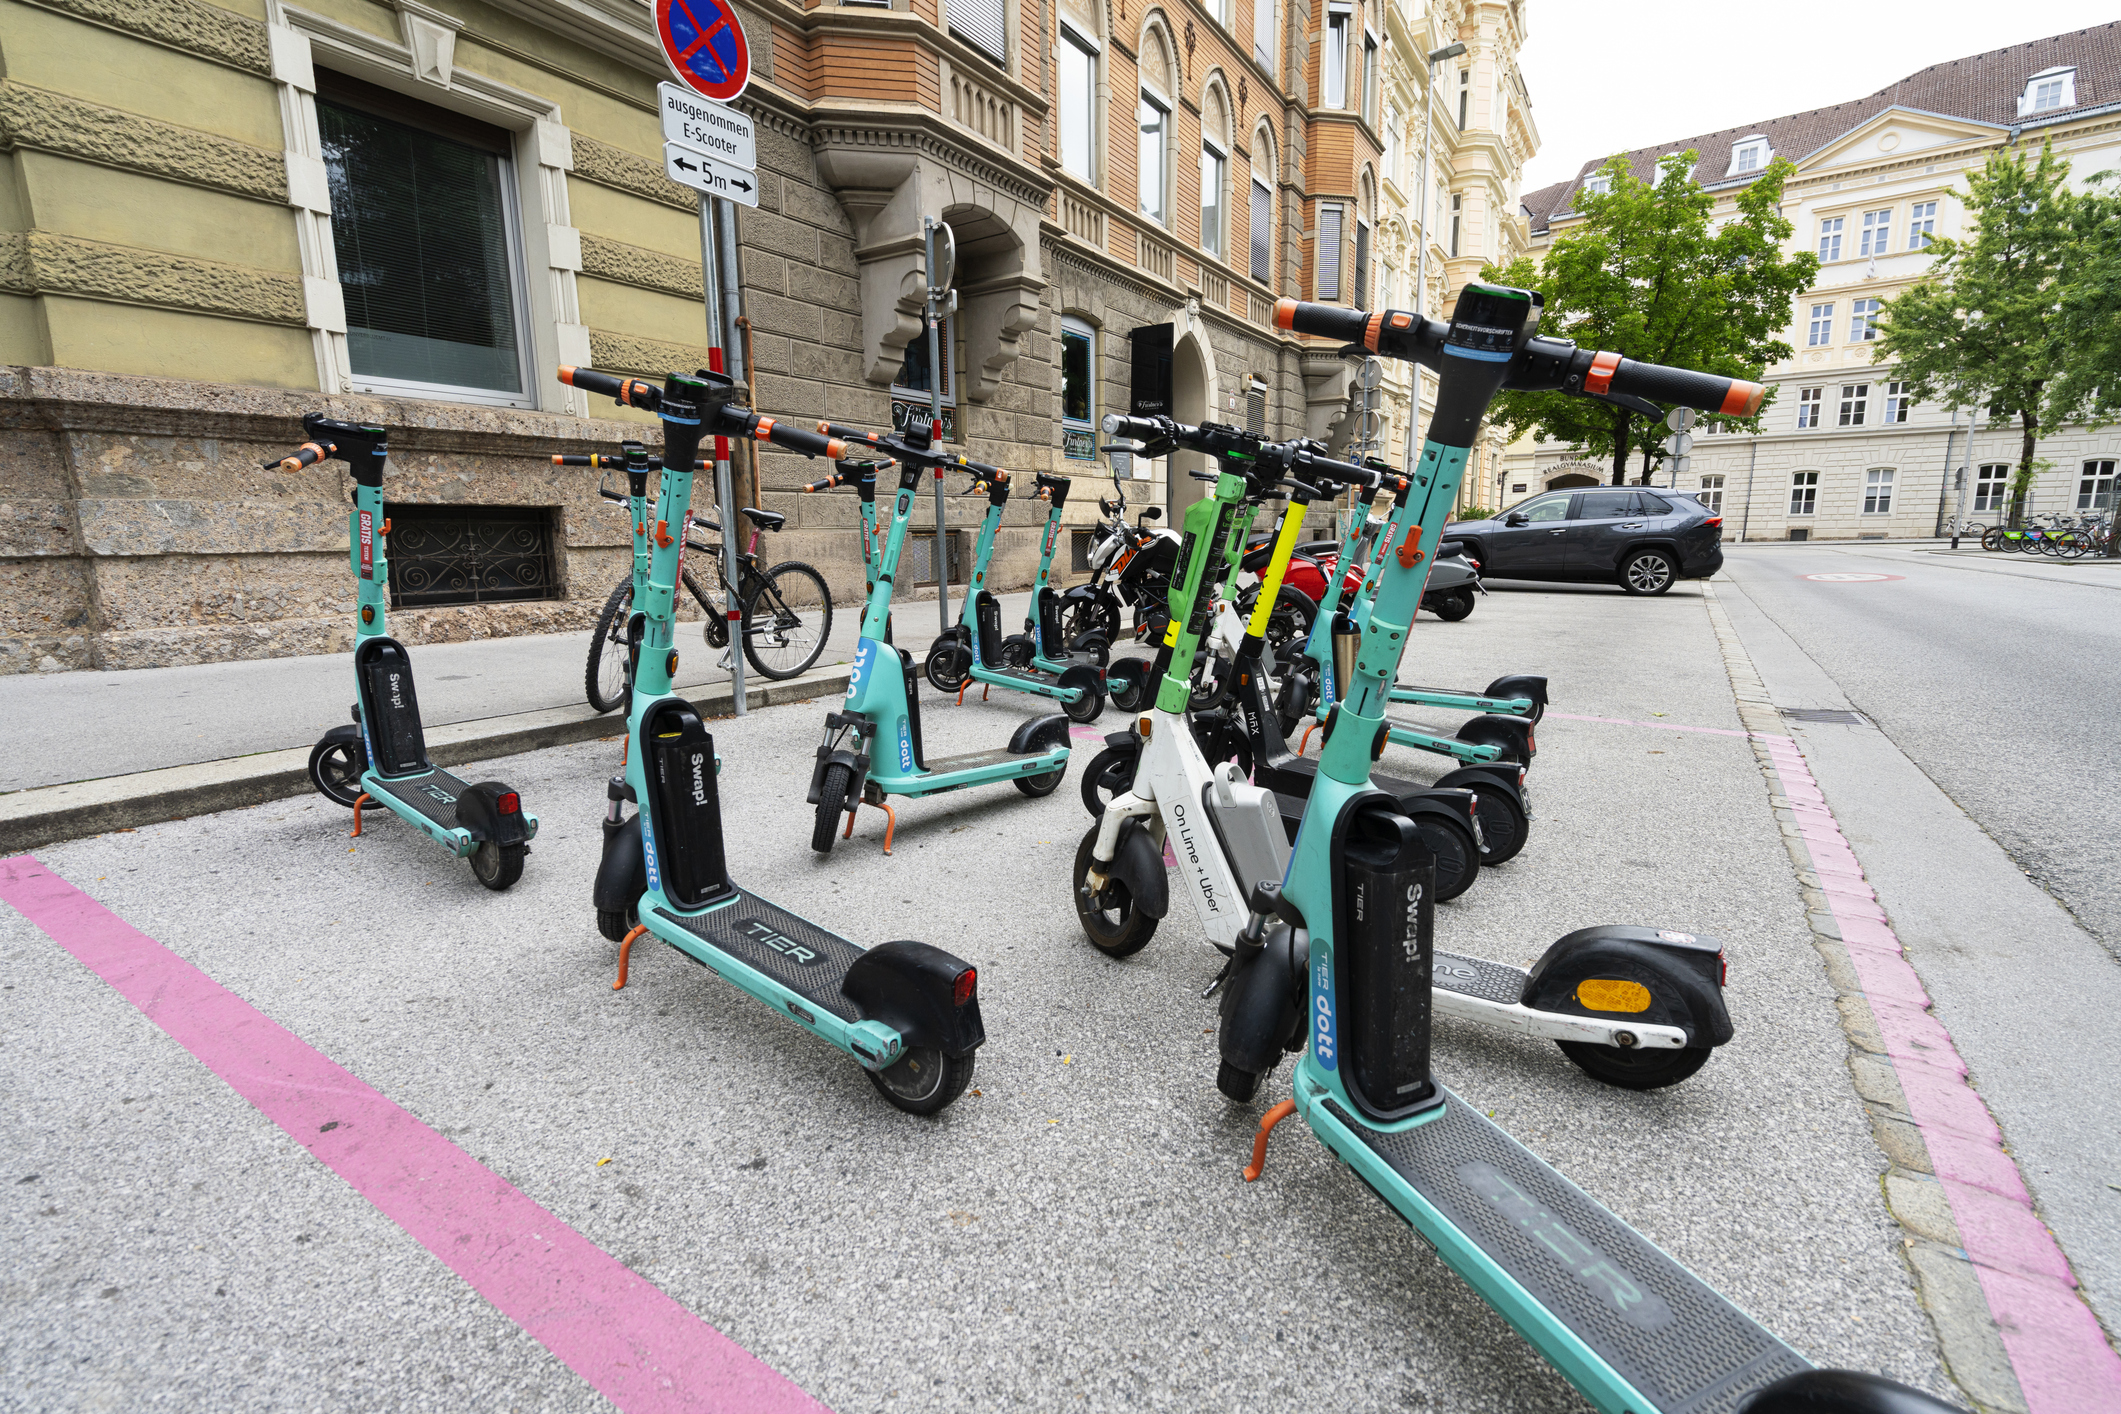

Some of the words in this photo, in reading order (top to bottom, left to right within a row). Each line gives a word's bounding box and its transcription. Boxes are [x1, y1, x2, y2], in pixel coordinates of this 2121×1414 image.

[668, 96, 749, 138] ausgenommen
[683, 122, 737, 155] E-Scooter
[702, 161, 727, 190] 5m
[1455, 322, 1514, 336] SICHERHEITSVORSCHRIFTEN
[901, 404, 952, 430] Furtnr's
[1543, 461, 1605, 475] REALGYMNASIUM
[360, 513, 372, 545] GRATIS
[1384, 523, 1397, 544] GRATIS
[389, 673, 405, 709] Swap!
[1325, 678, 1333, 700] dott
[900, 739, 911, 769] dott
[421, 784, 458, 805] TIER
[691, 752, 708, 807] Swap!
[1174, 804, 1187, 827] On
[645, 841, 658, 884] dott
[1180, 828, 1200, 864] Lime
[1199, 877, 1220, 913] Uber
[1356, 883, 1365, 922] TIER
[1402, 883, 1423, 963] Swap!
[747, 922, 816, 964] TIER
[1320, 951, 1329, 991] TIER
[1316, 994, 1334, 1059] dott
